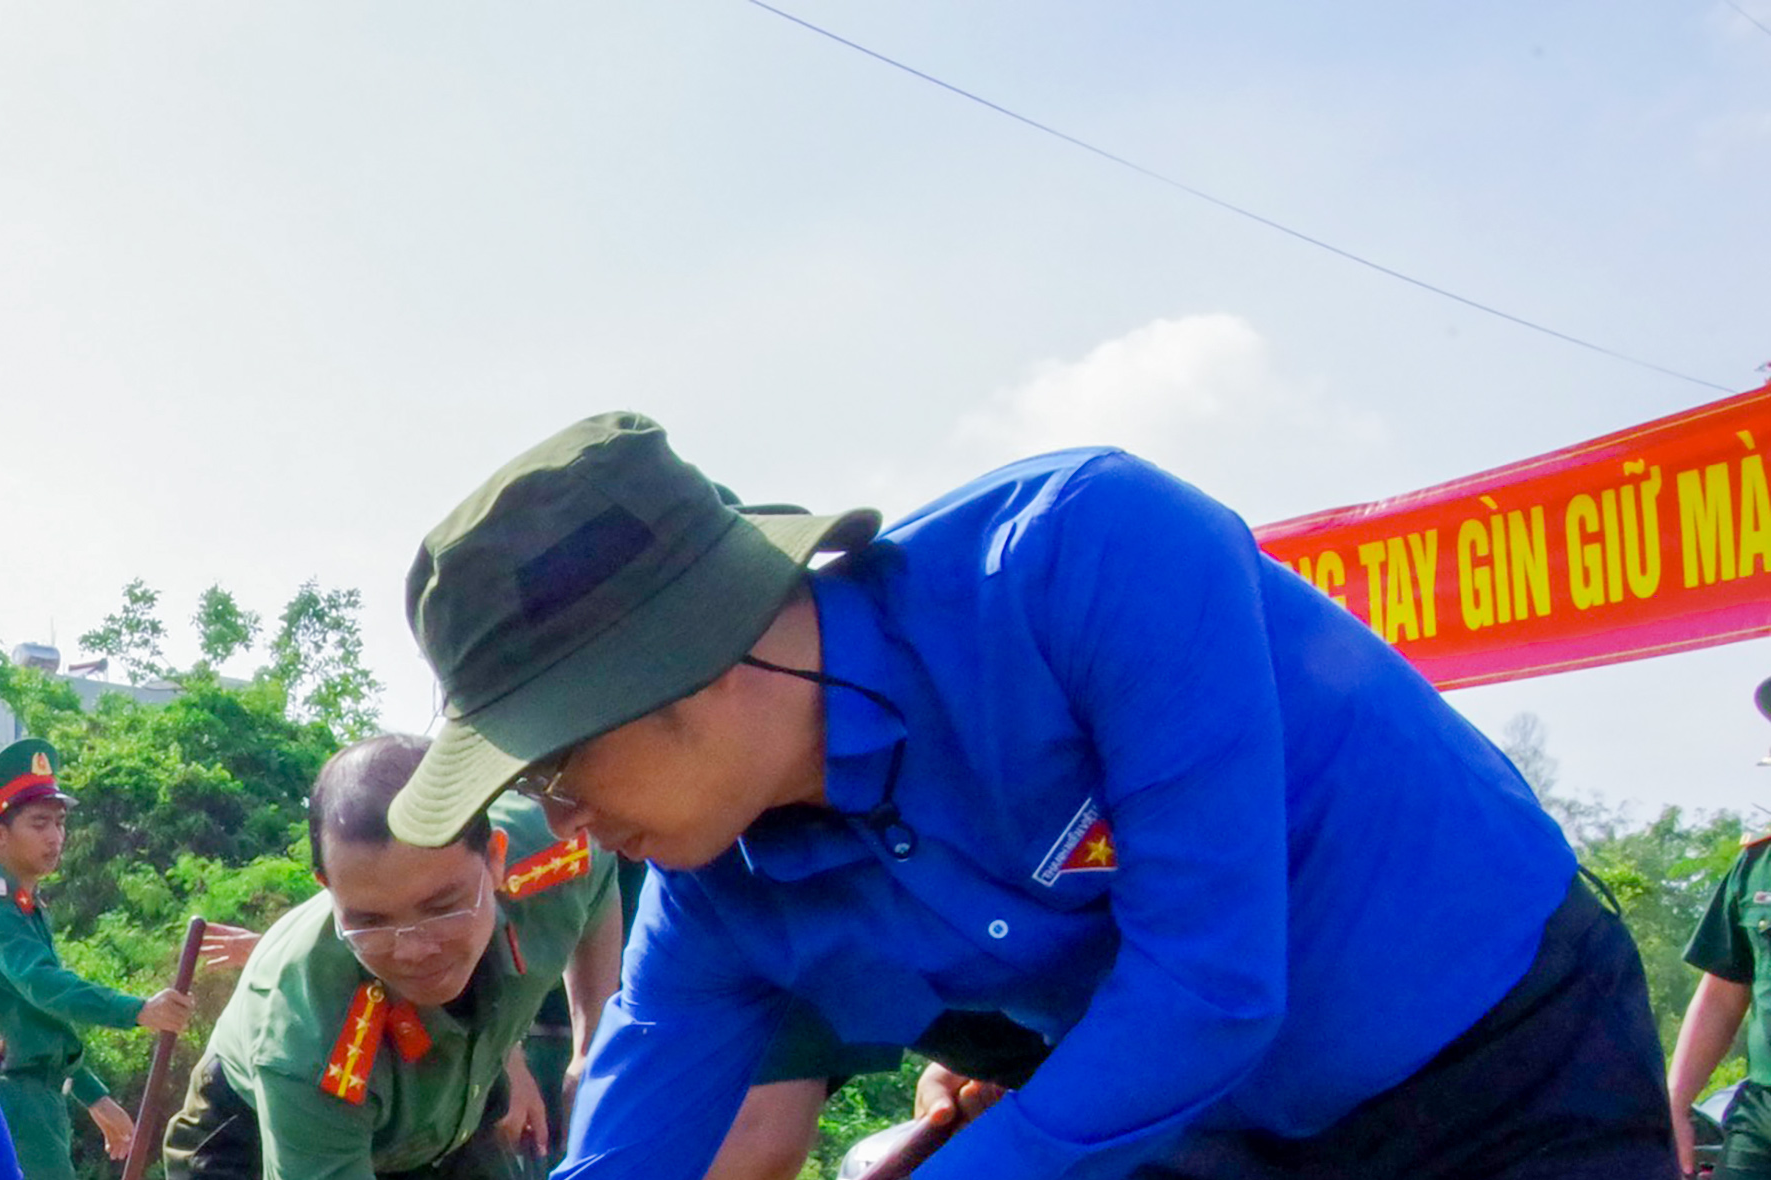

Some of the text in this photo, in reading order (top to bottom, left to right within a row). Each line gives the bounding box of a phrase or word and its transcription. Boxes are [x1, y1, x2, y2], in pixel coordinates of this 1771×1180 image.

[1358, 529, 1438, 644] TAY
[1458, 495, 1551, 631] GÌN
[1565, 458, 1662, 610] GIỮ
